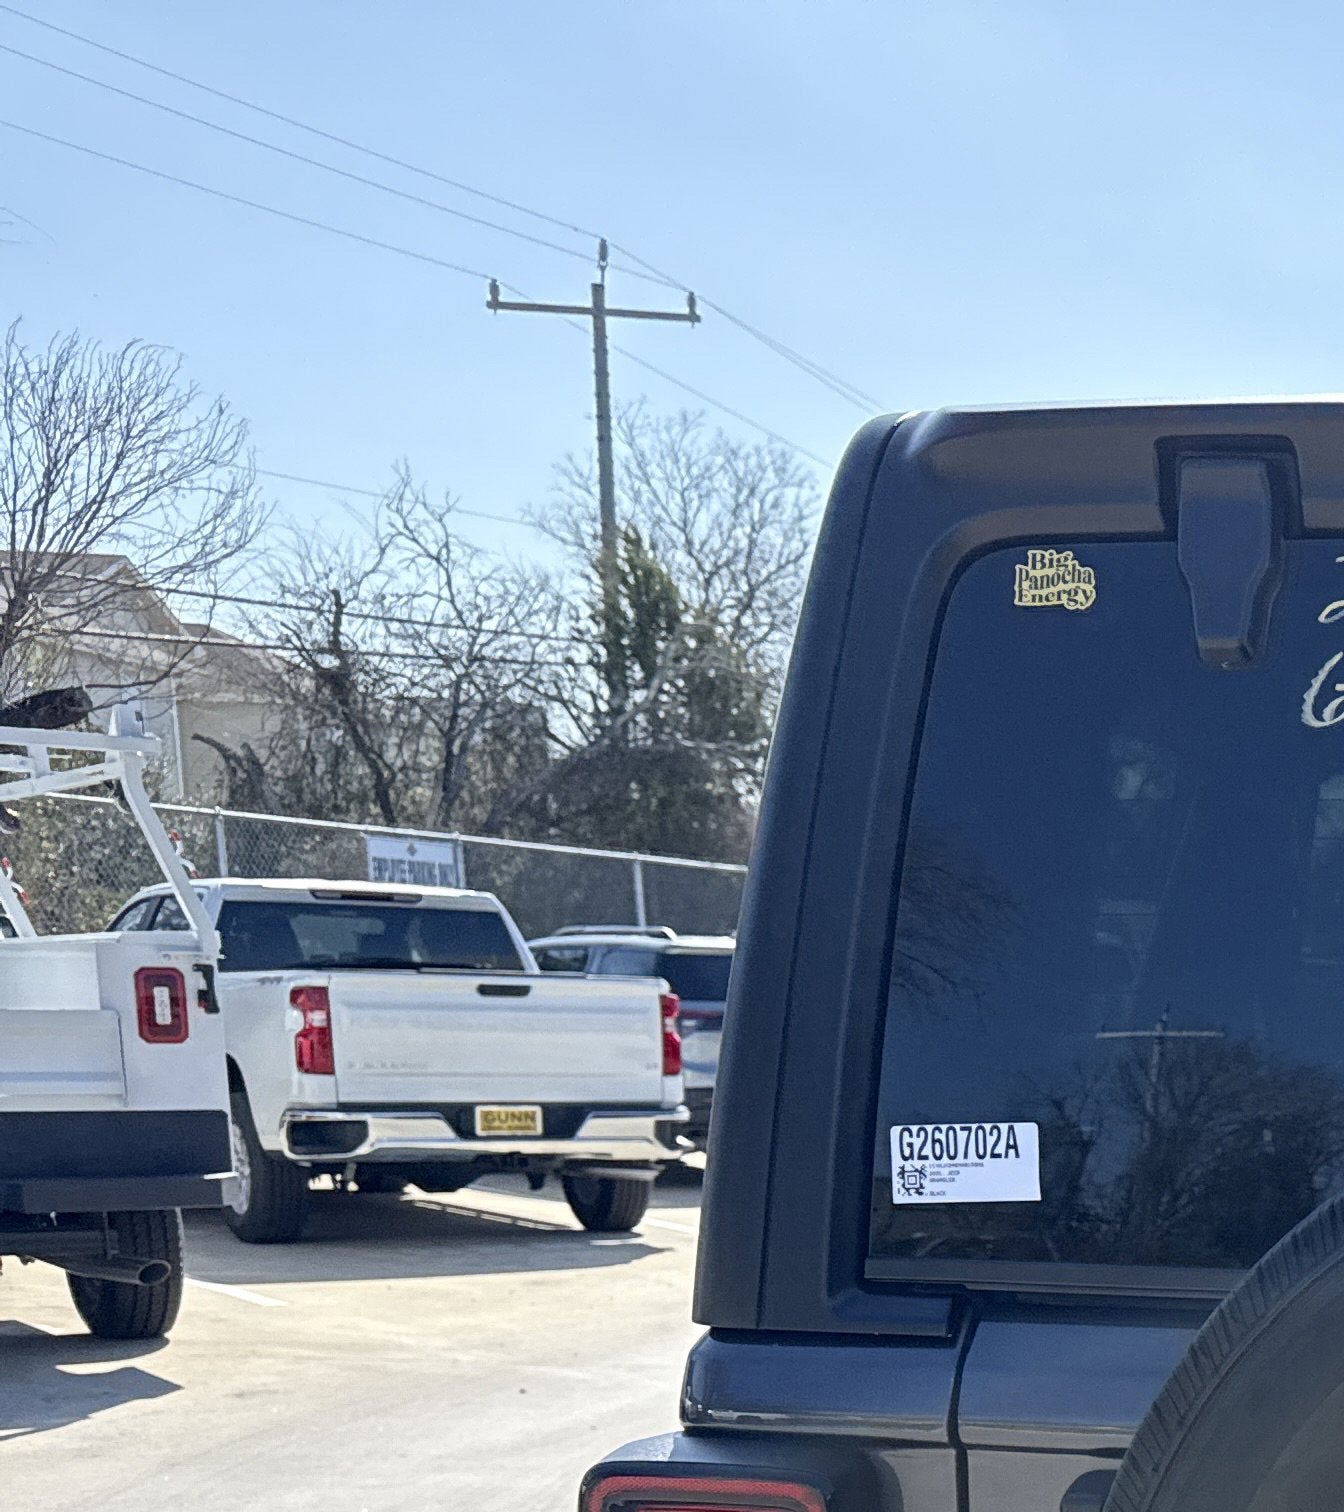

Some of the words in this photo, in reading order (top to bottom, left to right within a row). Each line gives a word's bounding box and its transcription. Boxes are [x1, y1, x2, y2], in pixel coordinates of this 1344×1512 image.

[1031, 552, 1071, 571] Big
[1017, 563, 1092, 590] Panocha
[1017, 586, 1094, 607] Energy
[484, 1111, 536, 1124] GUNN
[899, 1124, 1020, 1161] G260702A
